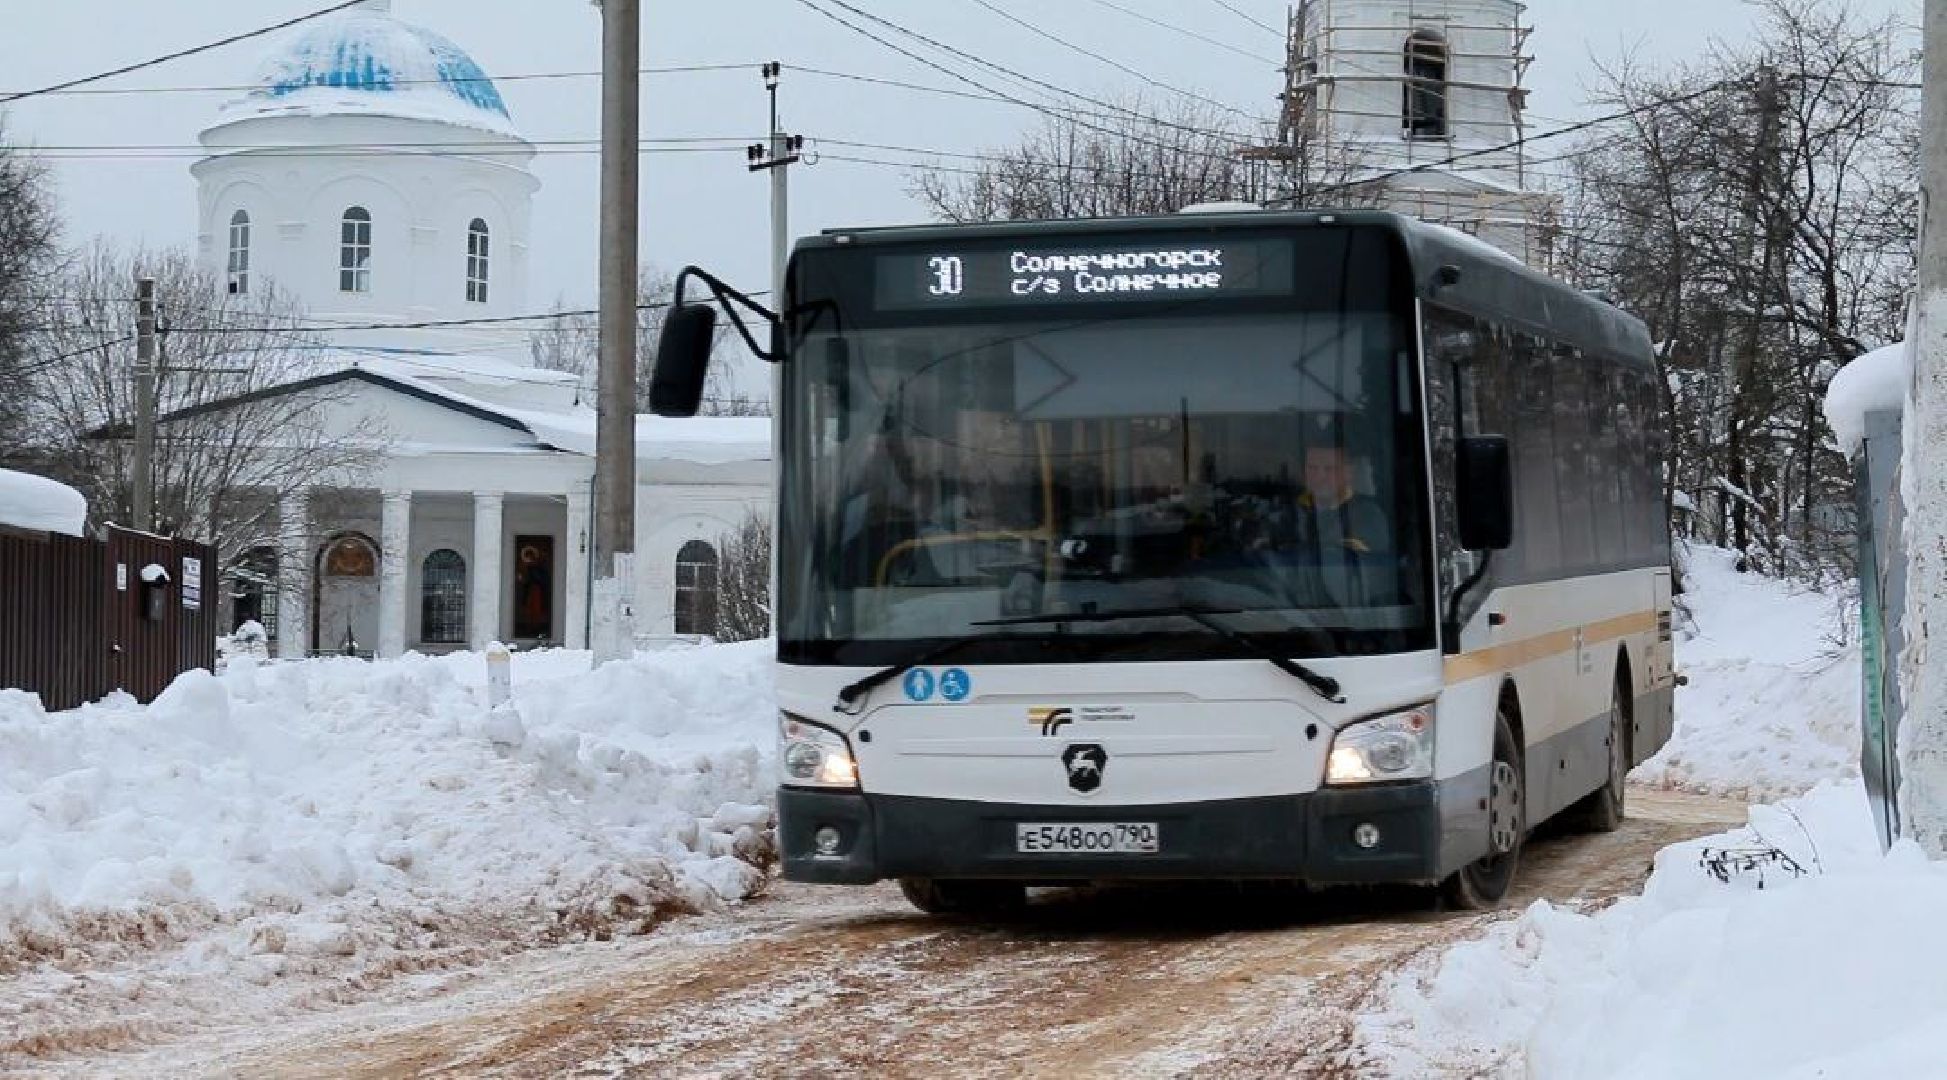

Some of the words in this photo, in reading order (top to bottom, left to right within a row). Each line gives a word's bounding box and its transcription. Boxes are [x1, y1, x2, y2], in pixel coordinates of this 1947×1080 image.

[1010, 249, 1222, 272] Солнечногорск
[928, 256, 963, 294] 30
[1074, 271, 1221, 294] Солнечное
